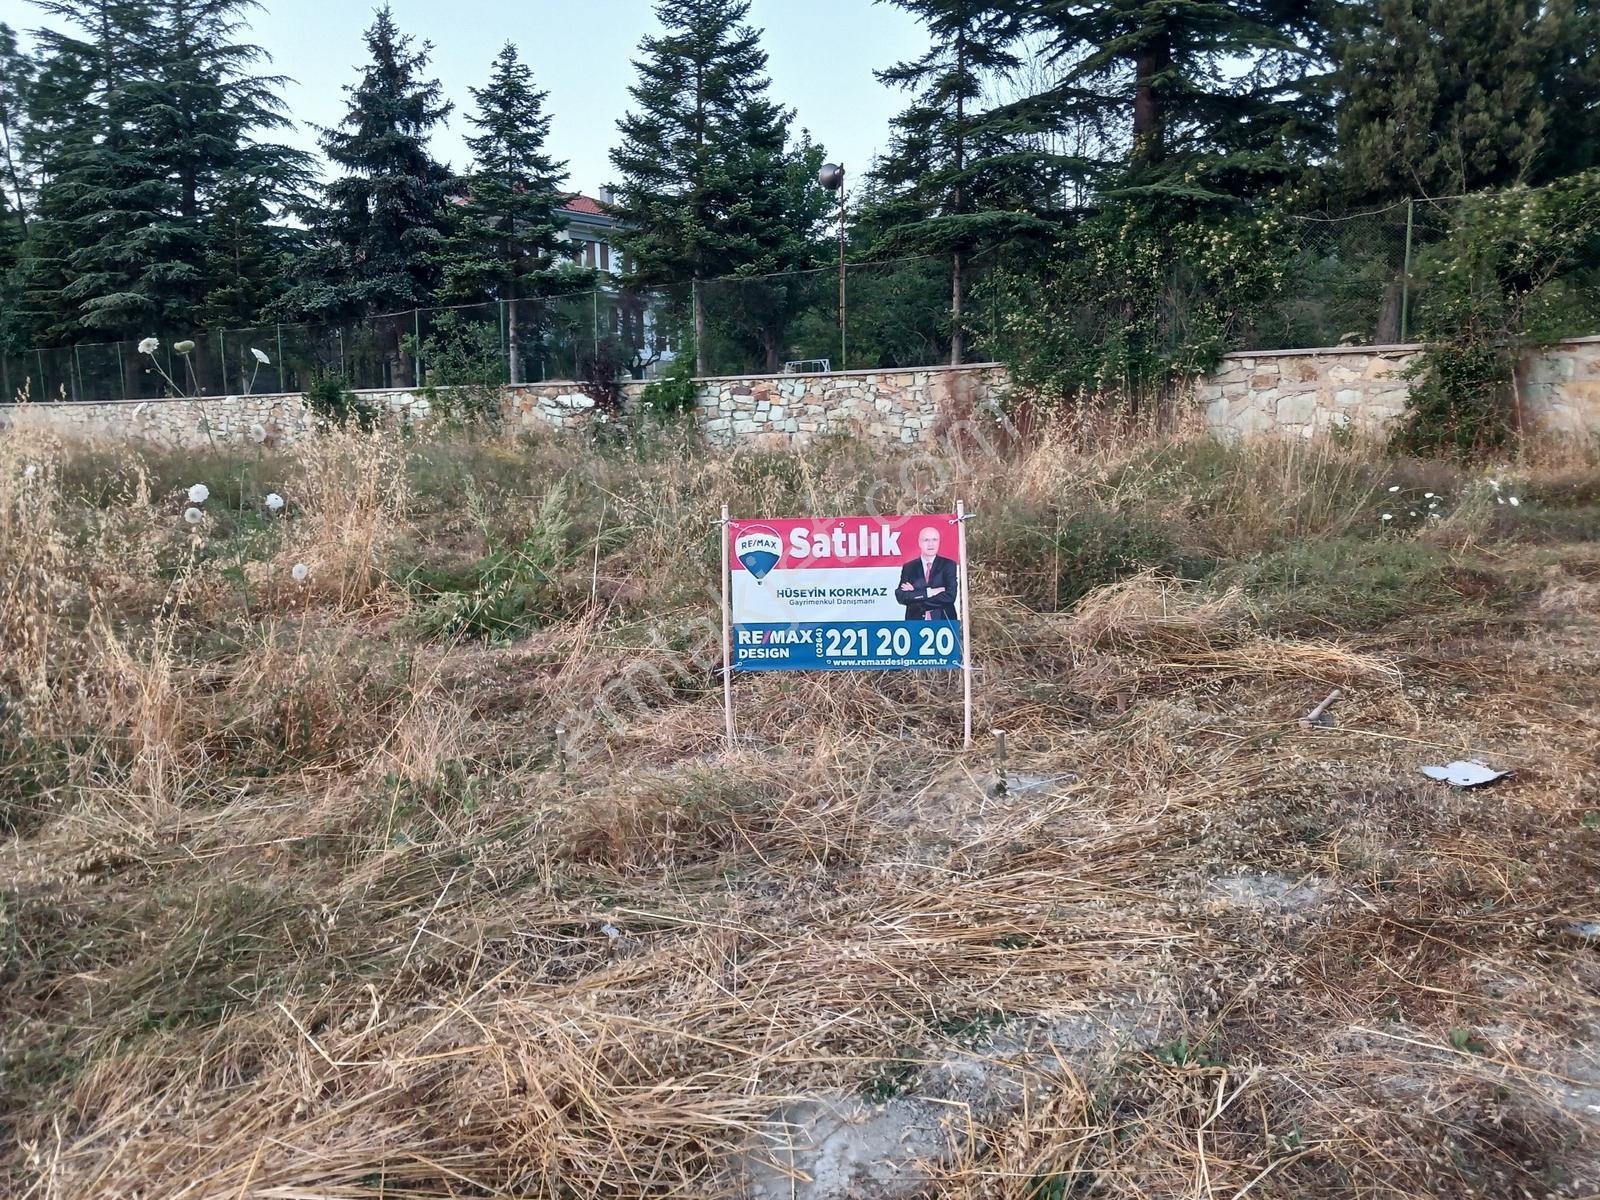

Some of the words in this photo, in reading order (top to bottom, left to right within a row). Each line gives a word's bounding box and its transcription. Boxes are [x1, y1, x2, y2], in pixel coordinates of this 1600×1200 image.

[741, 539, 777, 550] RE/MAX
[789, 525, 902, 559] Satılık
[776, 587, 826, 598] HÜSEYİN
[829, 587, 888, 598] KORKMAZ
[789, 598, 836, 607] Gayrimenkul
[836, 598, 876, 606] Danışmanı
[738, 630, 813, 645] RE/MAX
[825, 628, 868, 657] 221
[876, 627, 912, 656] 20
[918, 626, 955, 656] 20
[738, 648, 790, 659] DESIGN
[833, 657, 948, 667] www.remaxdesign.com.tr
